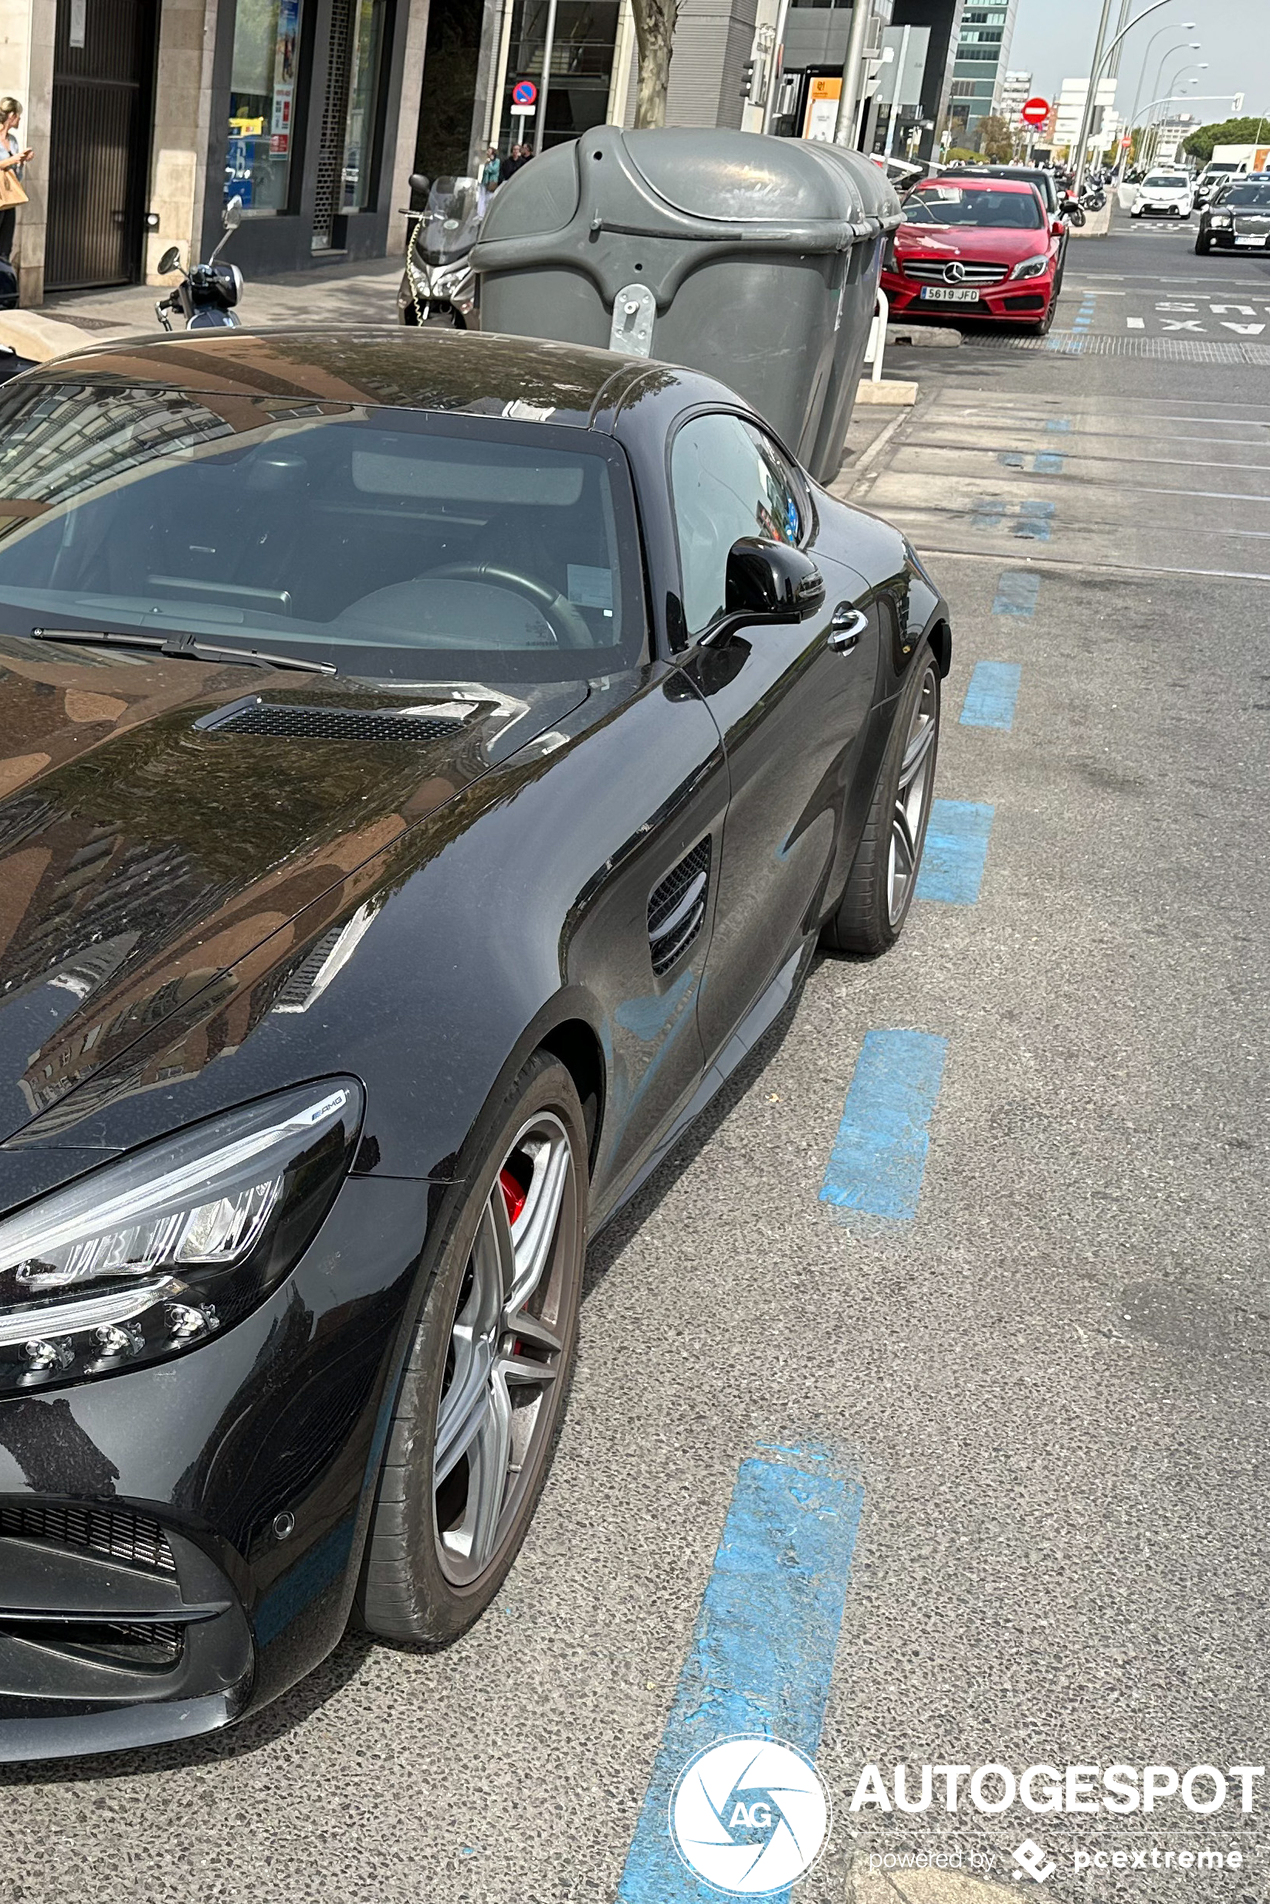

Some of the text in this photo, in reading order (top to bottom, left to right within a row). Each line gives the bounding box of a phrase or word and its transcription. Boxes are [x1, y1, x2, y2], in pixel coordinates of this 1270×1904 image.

[928, 288, 978, 301] 5619 JFD
[1154, 301, 1270, 316] US
[1126, 316, 1267, 335] AXI
